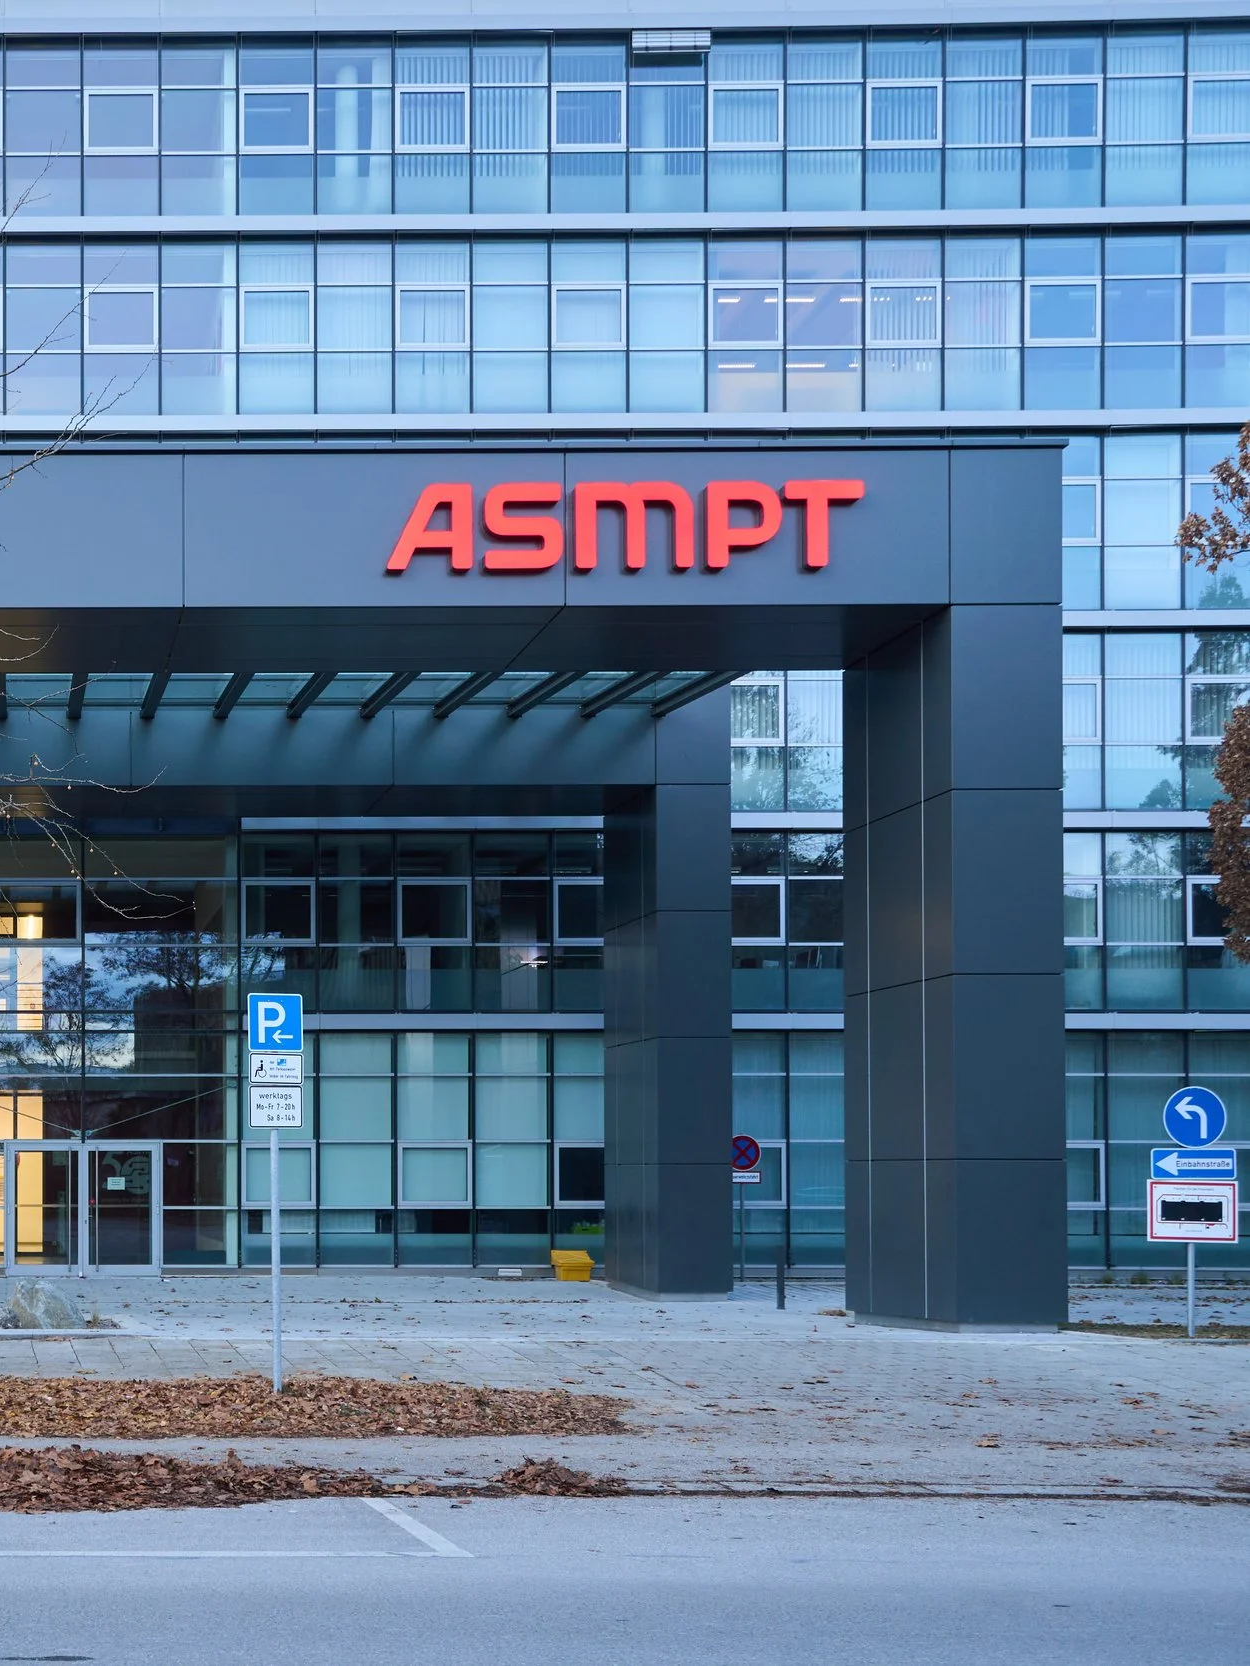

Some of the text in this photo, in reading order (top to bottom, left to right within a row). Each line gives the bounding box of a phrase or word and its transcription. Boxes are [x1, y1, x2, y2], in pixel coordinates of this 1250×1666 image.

[386, 480, 865, 573] ASMPT
[257, 1001, 286, 1043] P
[259, 1093, 292, 1101] werktags
[1175, 1160, 1231, 1168] Einbahnstraße
